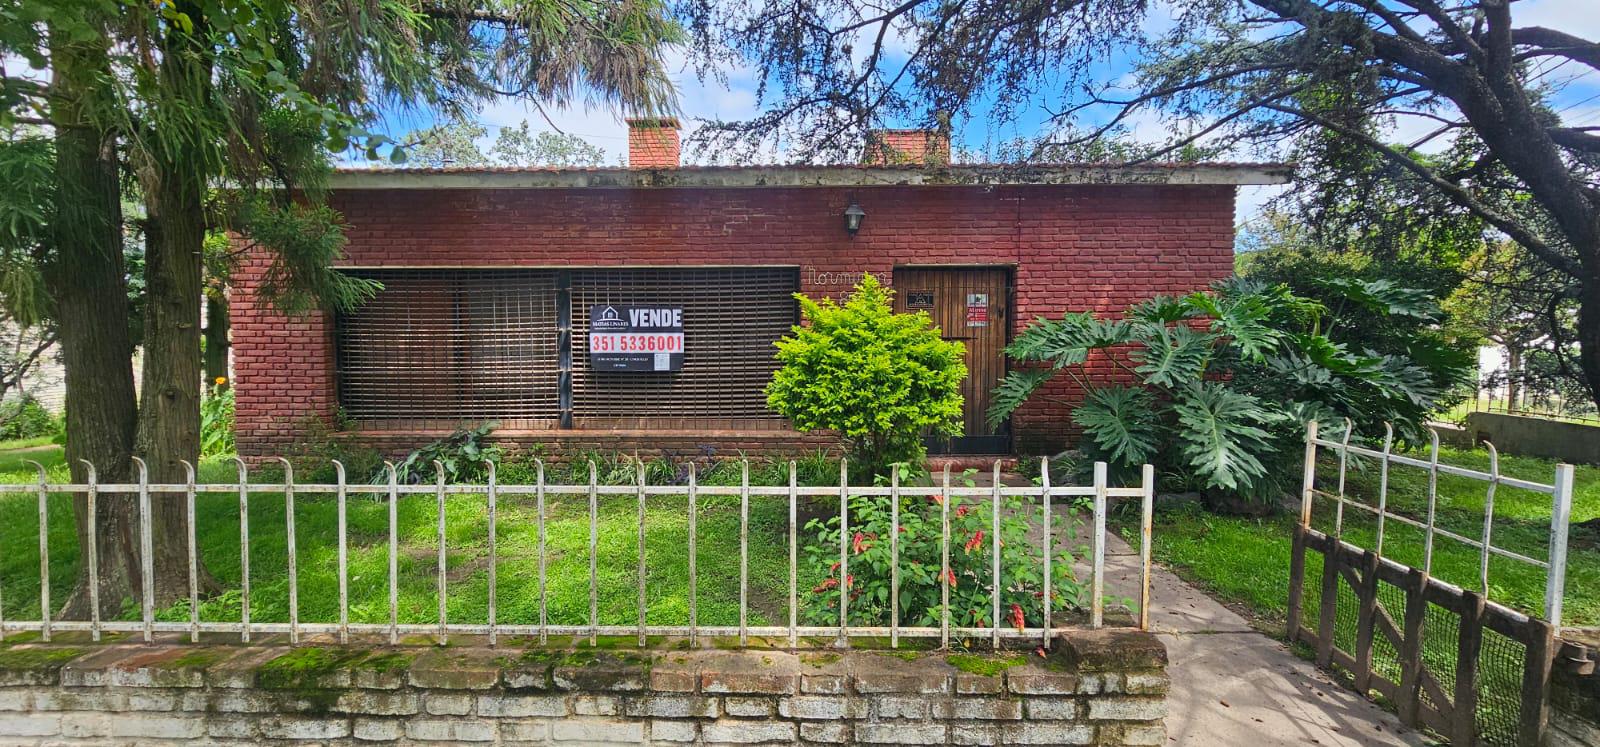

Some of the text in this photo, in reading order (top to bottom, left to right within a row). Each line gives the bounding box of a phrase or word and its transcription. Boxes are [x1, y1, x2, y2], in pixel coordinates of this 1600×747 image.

[629, 308, 682, 327] VENDE
[593, 335, 681, 351] 351 5336001
